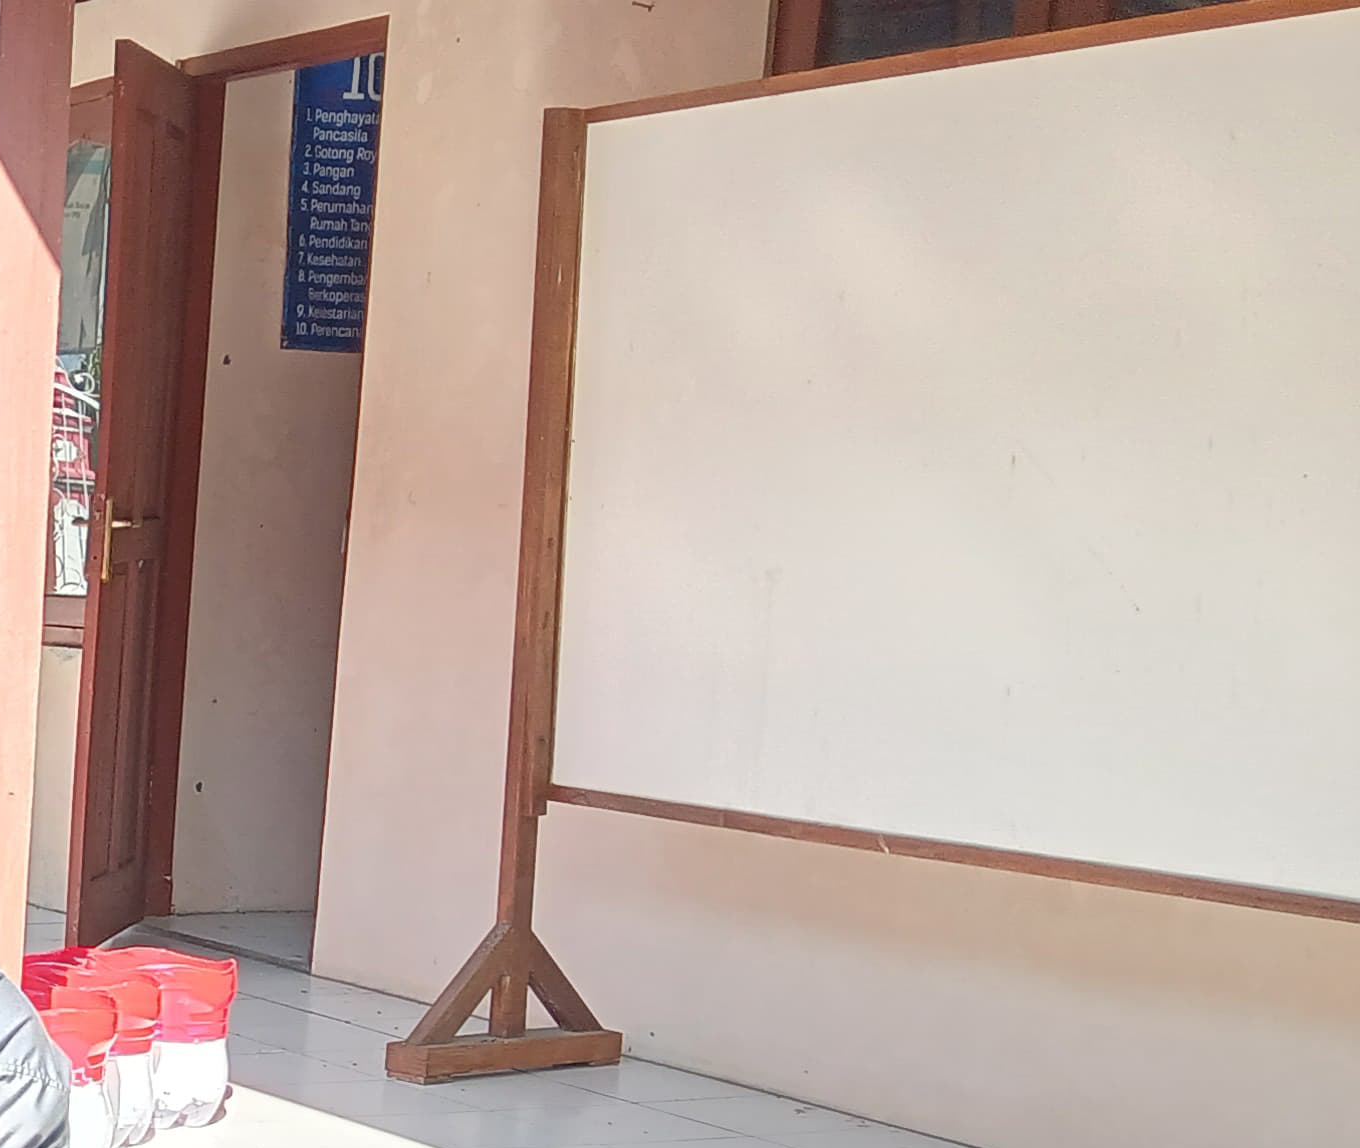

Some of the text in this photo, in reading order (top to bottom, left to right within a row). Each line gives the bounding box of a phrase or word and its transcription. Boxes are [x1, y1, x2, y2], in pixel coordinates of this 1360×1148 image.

[313, 126, 368, 143] Pancasila
[314, 145, 354, 164] Gotong
[313, 163, 354, 181] Pangan
[312, 181, 361, 199] Sandang
[310, 216, 348, 232] Rumah
[308, 235, 368, 250] Pendidikan
[307, 252, 362, 267] Kesehatan
[311, 323, 362, 338] Perencan
